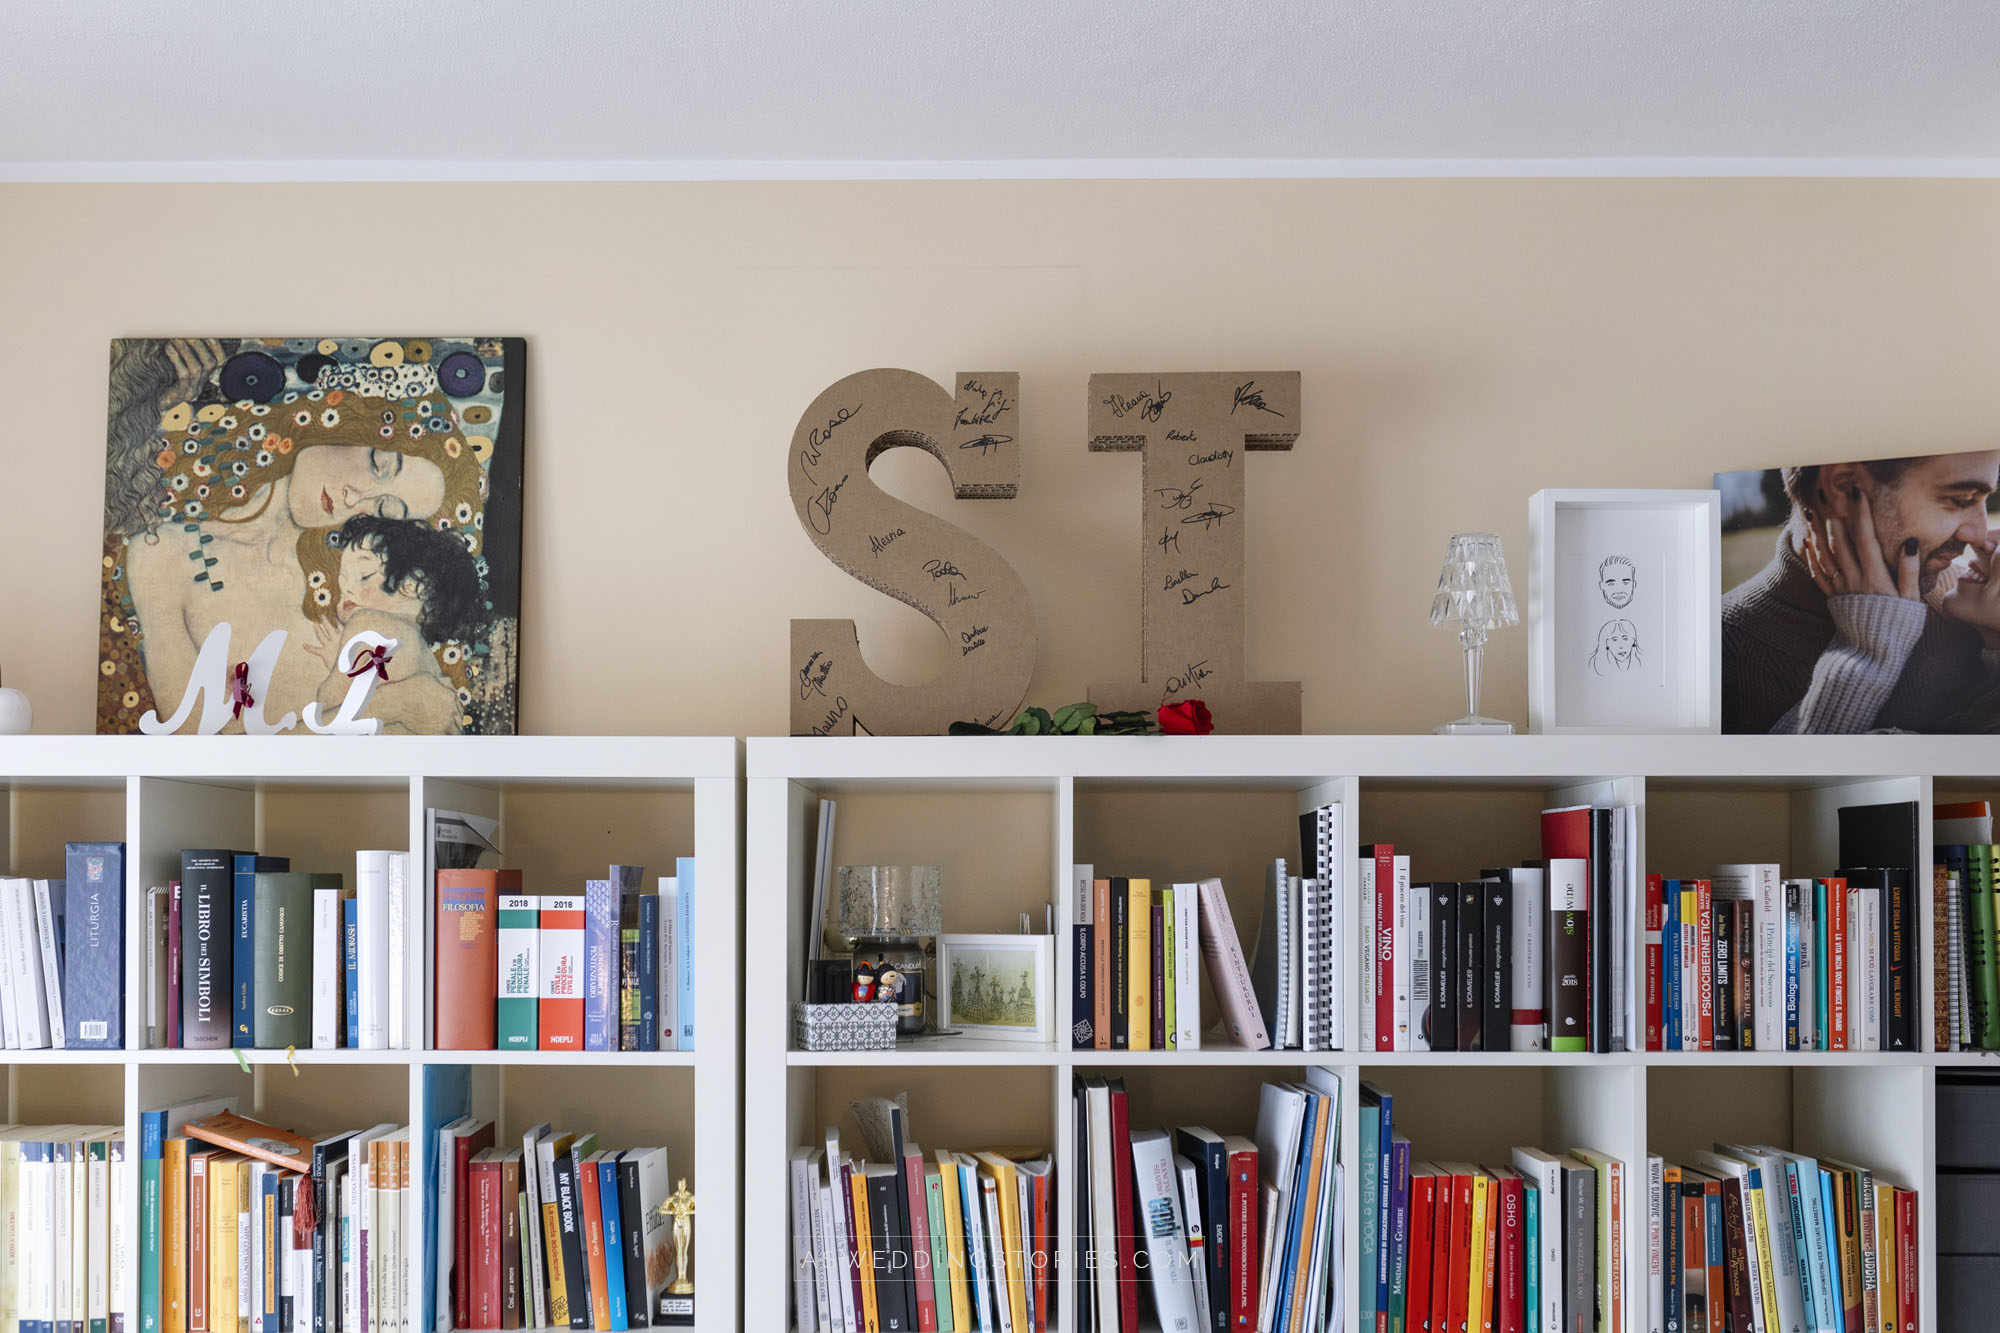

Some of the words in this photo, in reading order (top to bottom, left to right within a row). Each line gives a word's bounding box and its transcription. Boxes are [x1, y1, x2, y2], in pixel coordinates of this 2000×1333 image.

[199, 883, 208, 893] IL
[1763, 870, 1772, 884] Jack
[508, 898, 529, 908] 2018
[552, 899, 574, 909] 2018
[1399, 882, 1407, 904] piacere
[1563, 883, 1575, 910] wine
[1763, 885, 1772, 912] Canfield
[1892, 887, 1901, 909] L'ARTE
[197, 893, 212, 942] LIBRO
[442, 902, 487, 912] FILOSOFIA
[1399, 905, 1407, 914] del
[88, 892, 99, 948] LITURGIA
[240, 899, 249, 939] EUCARISTIA
[1399, 914, 1407, 929] vino
[1563, 910, 1575, 935] slow
[1892, 909, 1901, 930] DELLA
[1079, 933, 1087, 953] CORPO
[1363, 925, 1371, 945] SANO
[1787, 911, 1796, 954] Credenze
[1382, 927, 1393, 962] VINO
[1717, 939, 1728, 960] ZERO
[1892, 931, 1901, 962] VITTORIA
[1079, 952, 1087, 976] ACCUSA
[1363, 944, 1371, 973] VEGANO
[1648, 947, 1656, 968] nasce
[1701, 910, 1712, 1017] PSICOCIBERNETICA
[1788, 955, 1796, 974] delle
[516, 952, 524, 994] PROCEDURA
[522, 967, 530, 994] PENALE
[560, 955, 568, 995] PROCEDURA
[1561, 978, 1578, 987] 2018
[1717, 960, 1728, 985] LIMITS
[1893, 975, 1902, 991] PHIL
[197, 956, 212, 1023] SIMBOLI
[566, 974, 574, 995] CIVILE
[1079, 981, 1087, 1000] COLPO
[1363, 972, 1371, 1004] ITALIANO
[1648, 976, 1656, 1005] Stronze
[1743, 973, 1751, 1001] SECRET
[1788, 976, 1797, 1011] Biologia
[1743, 1002, 1751, 1019] THE
[1893, 992, 1902, 1018] KNIGHT
[558, 1172, 570, 1185] MY
[1363, 1162, 1375, 1205] PILATES
[1650, 1163, 1660, 1185] NOVAK
[1788, 1173, 1798, 1195] ZERO
[560, 1186, 571, 1211] BLACK
[1577, 1178, 1585, 1197] Wayne
[1863, 1176, 1873, 1209] GIACOBBE
[547, 1205, 556, 1215] La
[1506, 1193, 1516, 1227] OSHO
[1577, 1197, 1585, 1205] W.
[1650, 1186, 1660, 1218] DJOKOVIC
[1669, 1189, 1677, 1210] POTERE
[1743, 1191, 1751, 1212] QUELLO
[563, 1211, 574, 1233] BOOK
[1364, 1207, 1373, 1217] e
[1577, 1205, 1585, 1219] Dyer
[1669, 1211, 1677, 1228] DELLE
[1791, 1196, 1803, 1240] CONCORRENTI
[1811, 1197, 1820, 1226] MARKETING
[549, 1215, 557, 1239] mente
[1363, 1220, 1375, 1255] YOGA
[1612, 1220, 1620, 1239] MILLE
[1650, 1227, 1660, 1248] PUNTO
[1612, 1239, 1620, 1258] NOMI
[1669, 1228, 1677, 1251] PAROLE
[1815, 1227, 1823, 1250] AFFILIATE
[550, 1239, 561, 1281] adolescente
[1612, 1258, 1620, 1271] PER
[1650, 1249, 1660, 1276] VINCENTE
[1669, 1256, 1677, 1273] DELLA
[1817, 1250, 1825, 1261] PER
[1612, 1272, 1620, 1280] LA
[1750, 1260, 1759, 1282] DEREK
[1818, 1261, 1828, 1296] COPYWRITING
[1612, 1280, 1620, 1300] GIOIA
[1752, 1283, 1761, 1305] SIVERS
